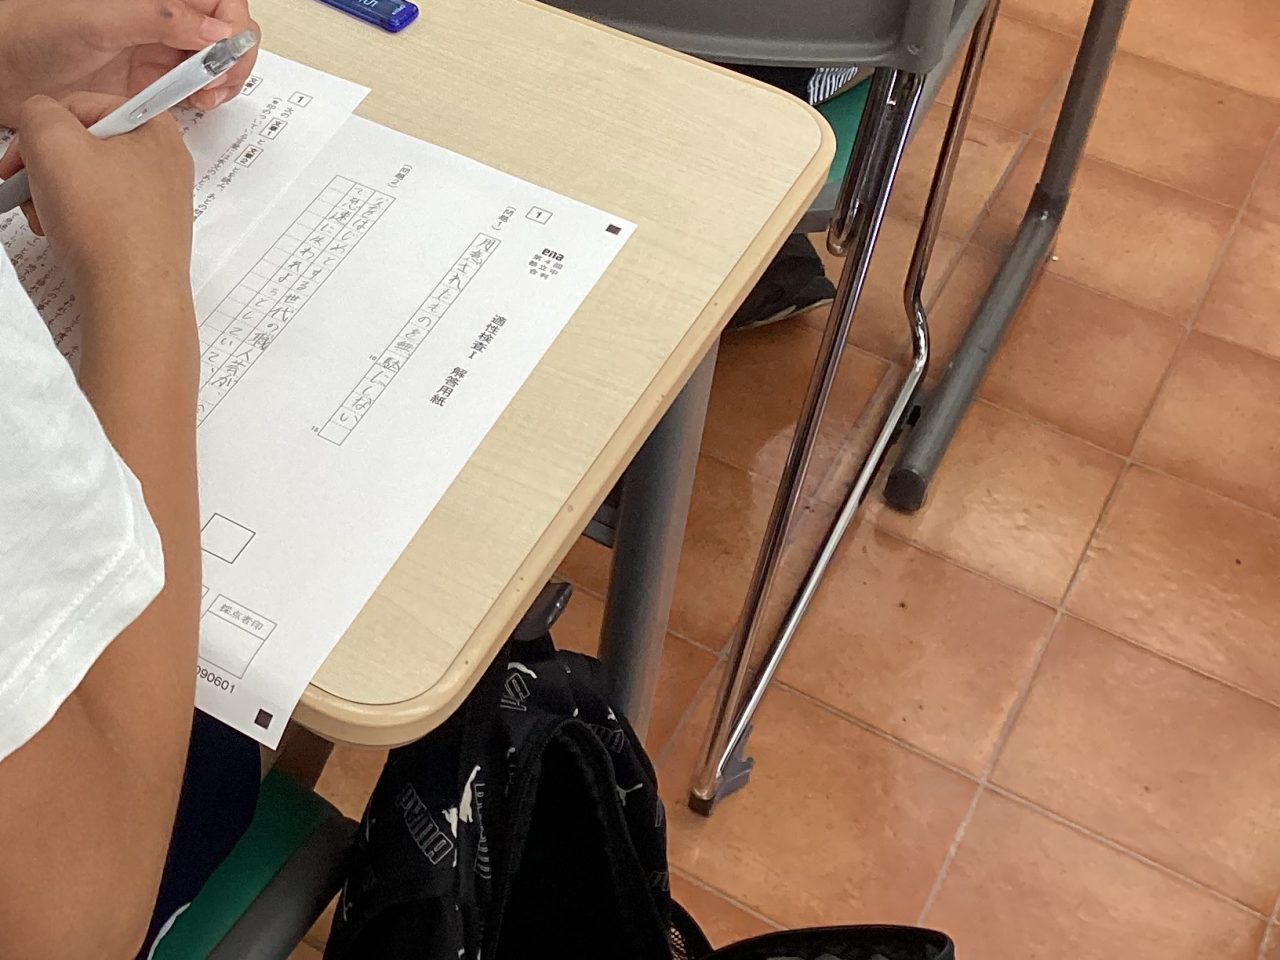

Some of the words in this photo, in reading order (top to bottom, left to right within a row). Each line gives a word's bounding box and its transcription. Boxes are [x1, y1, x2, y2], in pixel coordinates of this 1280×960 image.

[541, 248, 565, 261] ena
[429, 366, 468, 407] 解答用紙
[218, 603, 264, 632] 採点者印
